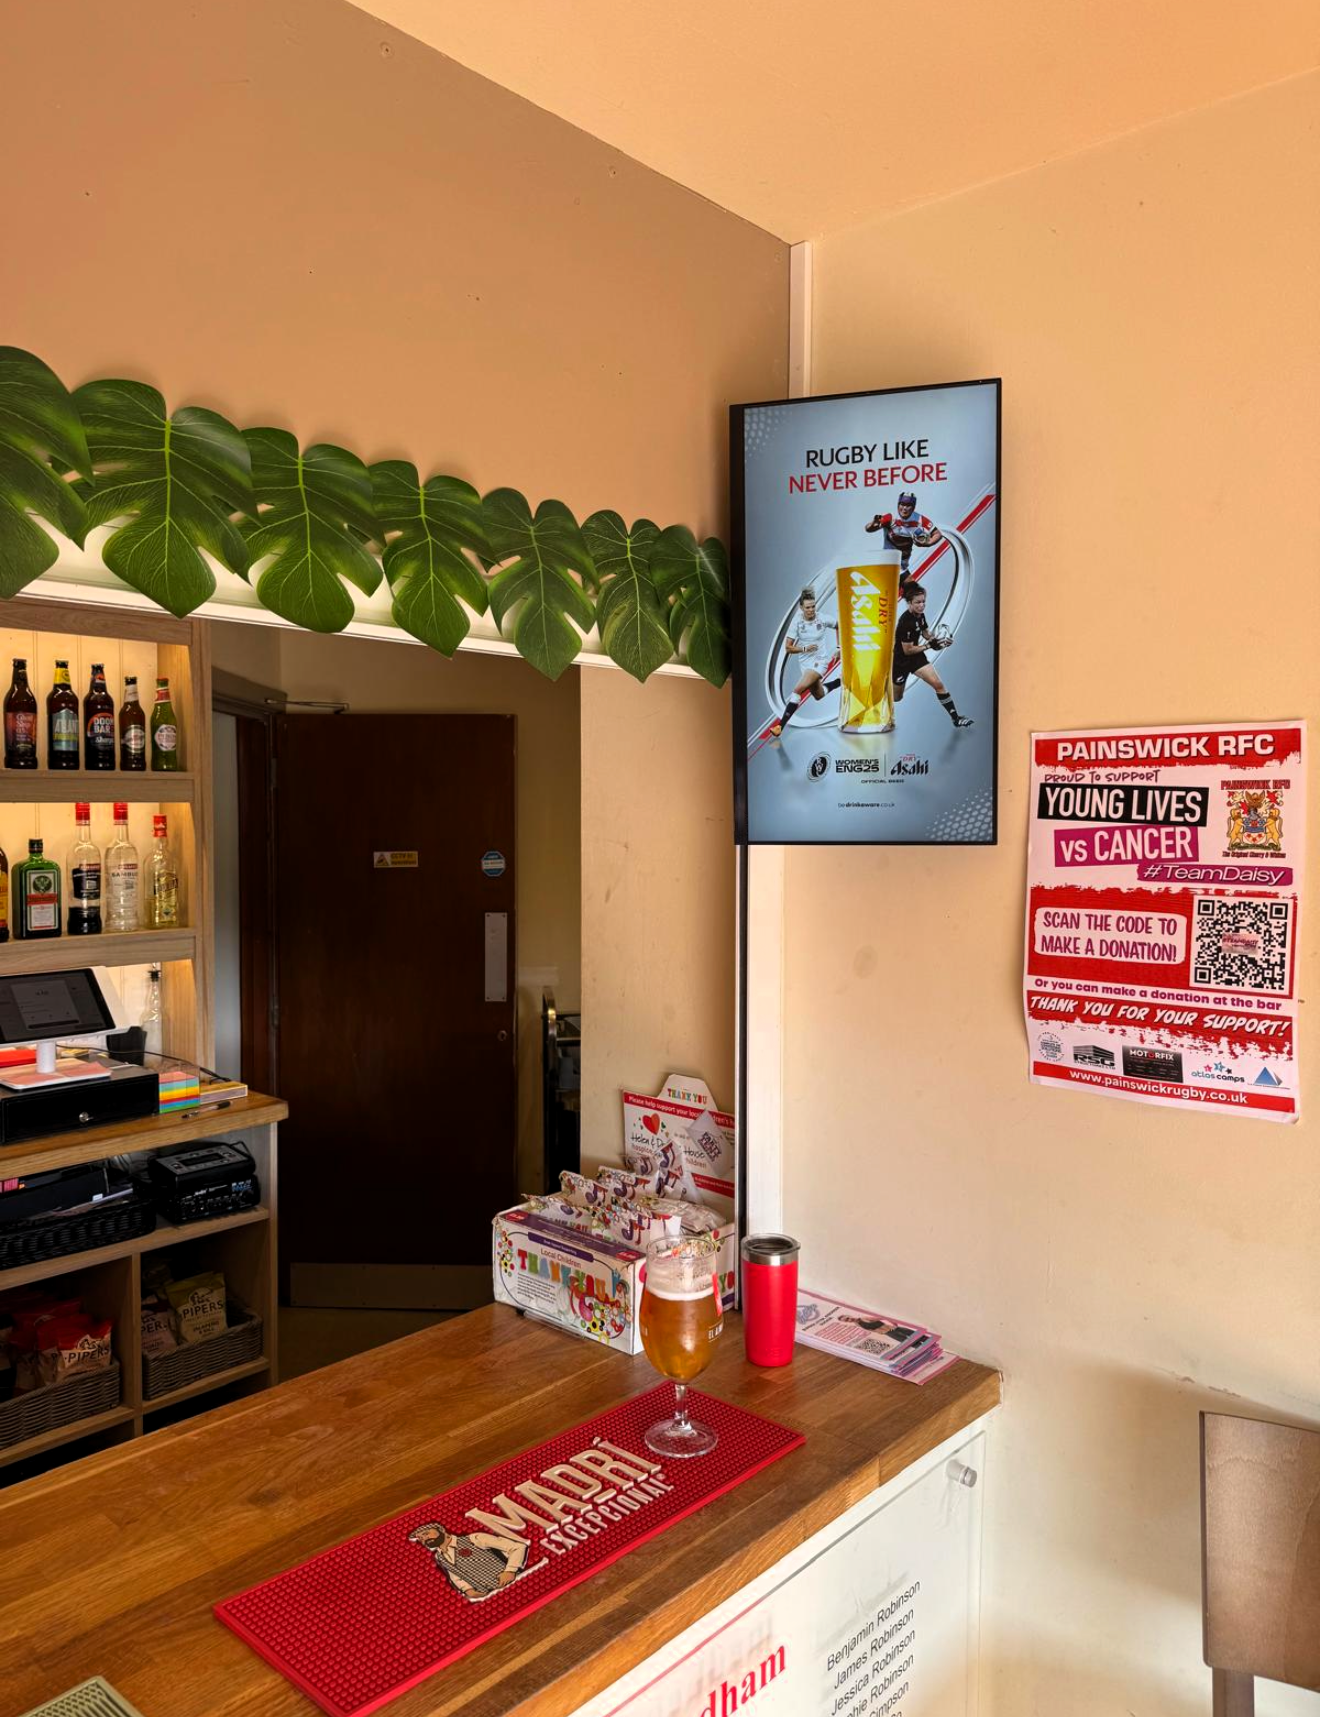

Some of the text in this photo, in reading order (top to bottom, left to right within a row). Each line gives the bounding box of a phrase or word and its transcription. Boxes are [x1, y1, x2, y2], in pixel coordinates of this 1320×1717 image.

[806, 439, 929, 468] RUGBY LIKE
[789, 462, 948, 494] NEVER BEFORE
[850, 571, 881, 651] Asahi
[879, 596, 888, 628] DRY
[1057, 733, 1275, 761] PAINSWICK RFC
[836, 765, 879, 773] ENG25
[890, 760, 929, 776] Asahi
[1044, 773, 1085, 783] PROUD
[1105, 769, 1160, 783] SUPPORT
[1045, 786, 1202, 823] YOUNG LIVES
[1060, 827, 1193, 863] vs CANCER
[1143, 864, 1285, 886] #TeamDaisy
[1043, 911, 1177, 936] SCAN THE CODE TO
[1041, 935, 1177, 962] MAKE A DONATION!
[1034, 978, 1282, 1011] Or you can make a donation at the bar
[1030, 995, 1292, 1038] THANK YOU FOR YOUR SUPPORT!
[1074, 1053, 1115, 1067] RSG
[1069, 1068, 1248, 1104] www.painswickrugby.co.uk
[1191, 1070, 1245, 1083] atlas camps
[645, 1100, 656, 1109] help
[657, 1103, 675, 1113] support
[676, 1107, 689, 1116] your
[668, 1088, 708, 1105] THANK YOU
[541, 1248, 582, 1268] Local Children
[182, 1300, 224, 1319] PIPERS
[68, 1347, 110, 1363] PIPERS
[539, 1474, 675, 1556] EXCEPCIONAL
[827, 1581, 920, 1671] Benjamin Robinson
[834, 1609, 914, 1690] James Robinson
[831, 1629, 915, 1717] Jessica Robinson
[870, 1654, 914, 1703] Robinson
